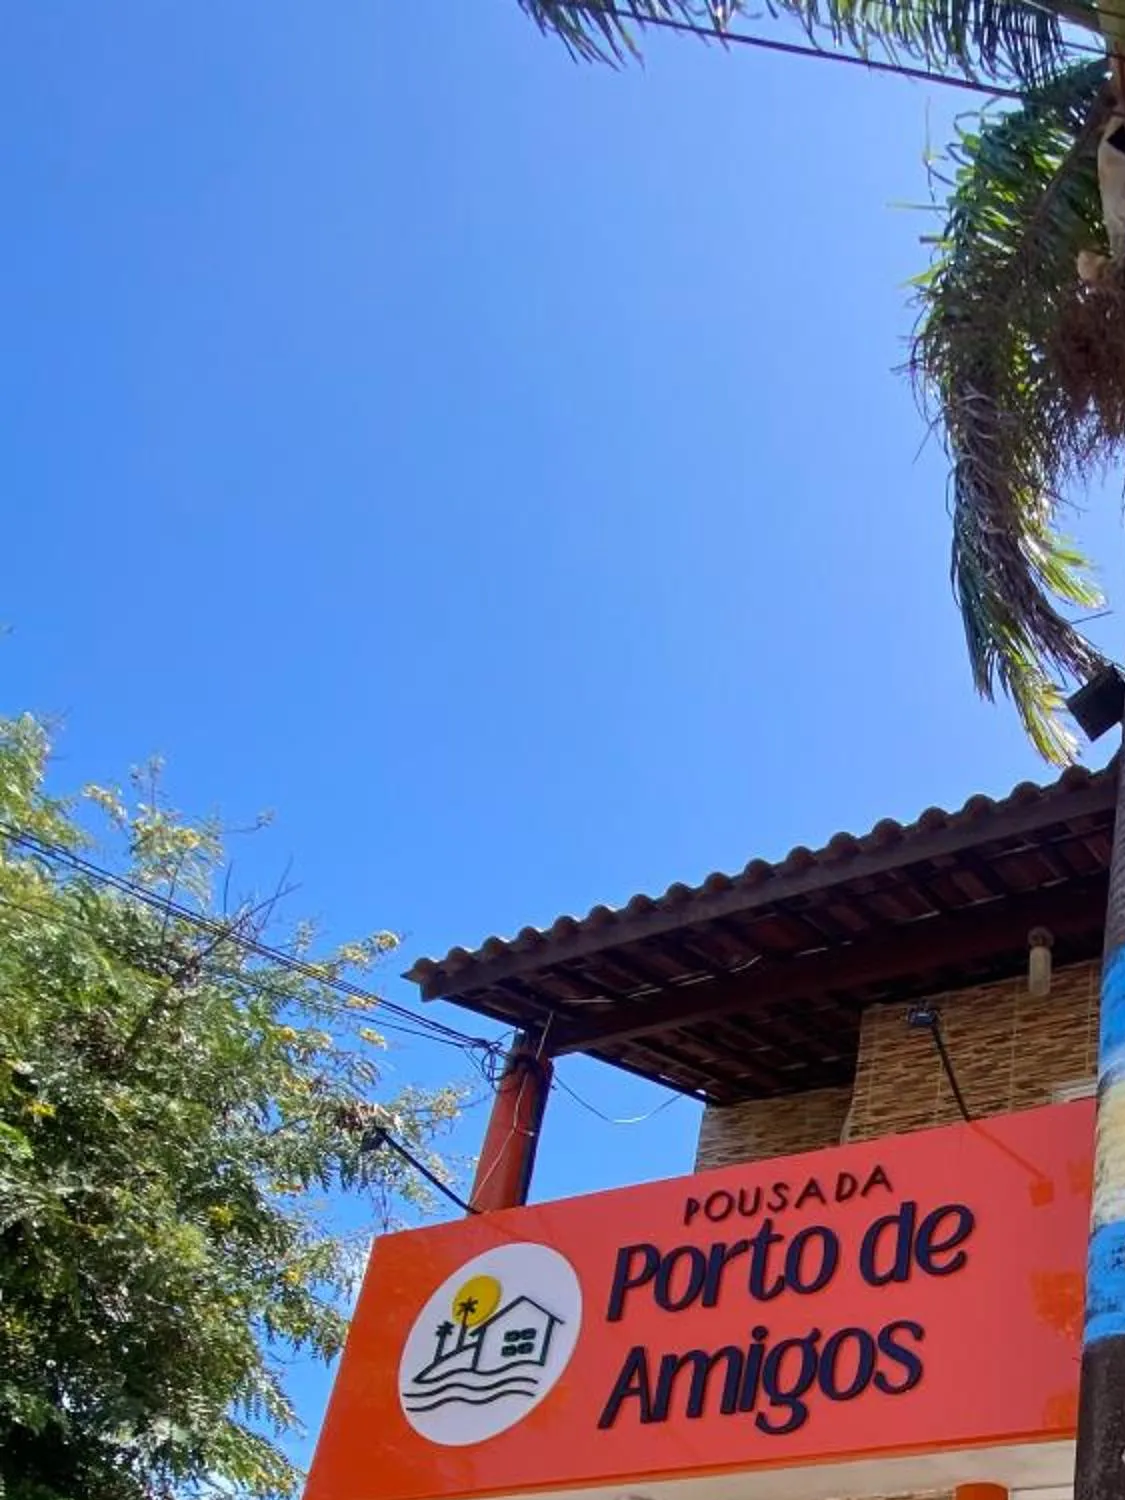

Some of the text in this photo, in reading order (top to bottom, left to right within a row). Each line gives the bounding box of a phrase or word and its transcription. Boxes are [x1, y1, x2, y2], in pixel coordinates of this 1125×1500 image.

[681, 1165, 893, 1226] POUSADA
[606, 1200, 975, 1323] Porto de
[597, 1320, 925, 1435] Amigos
